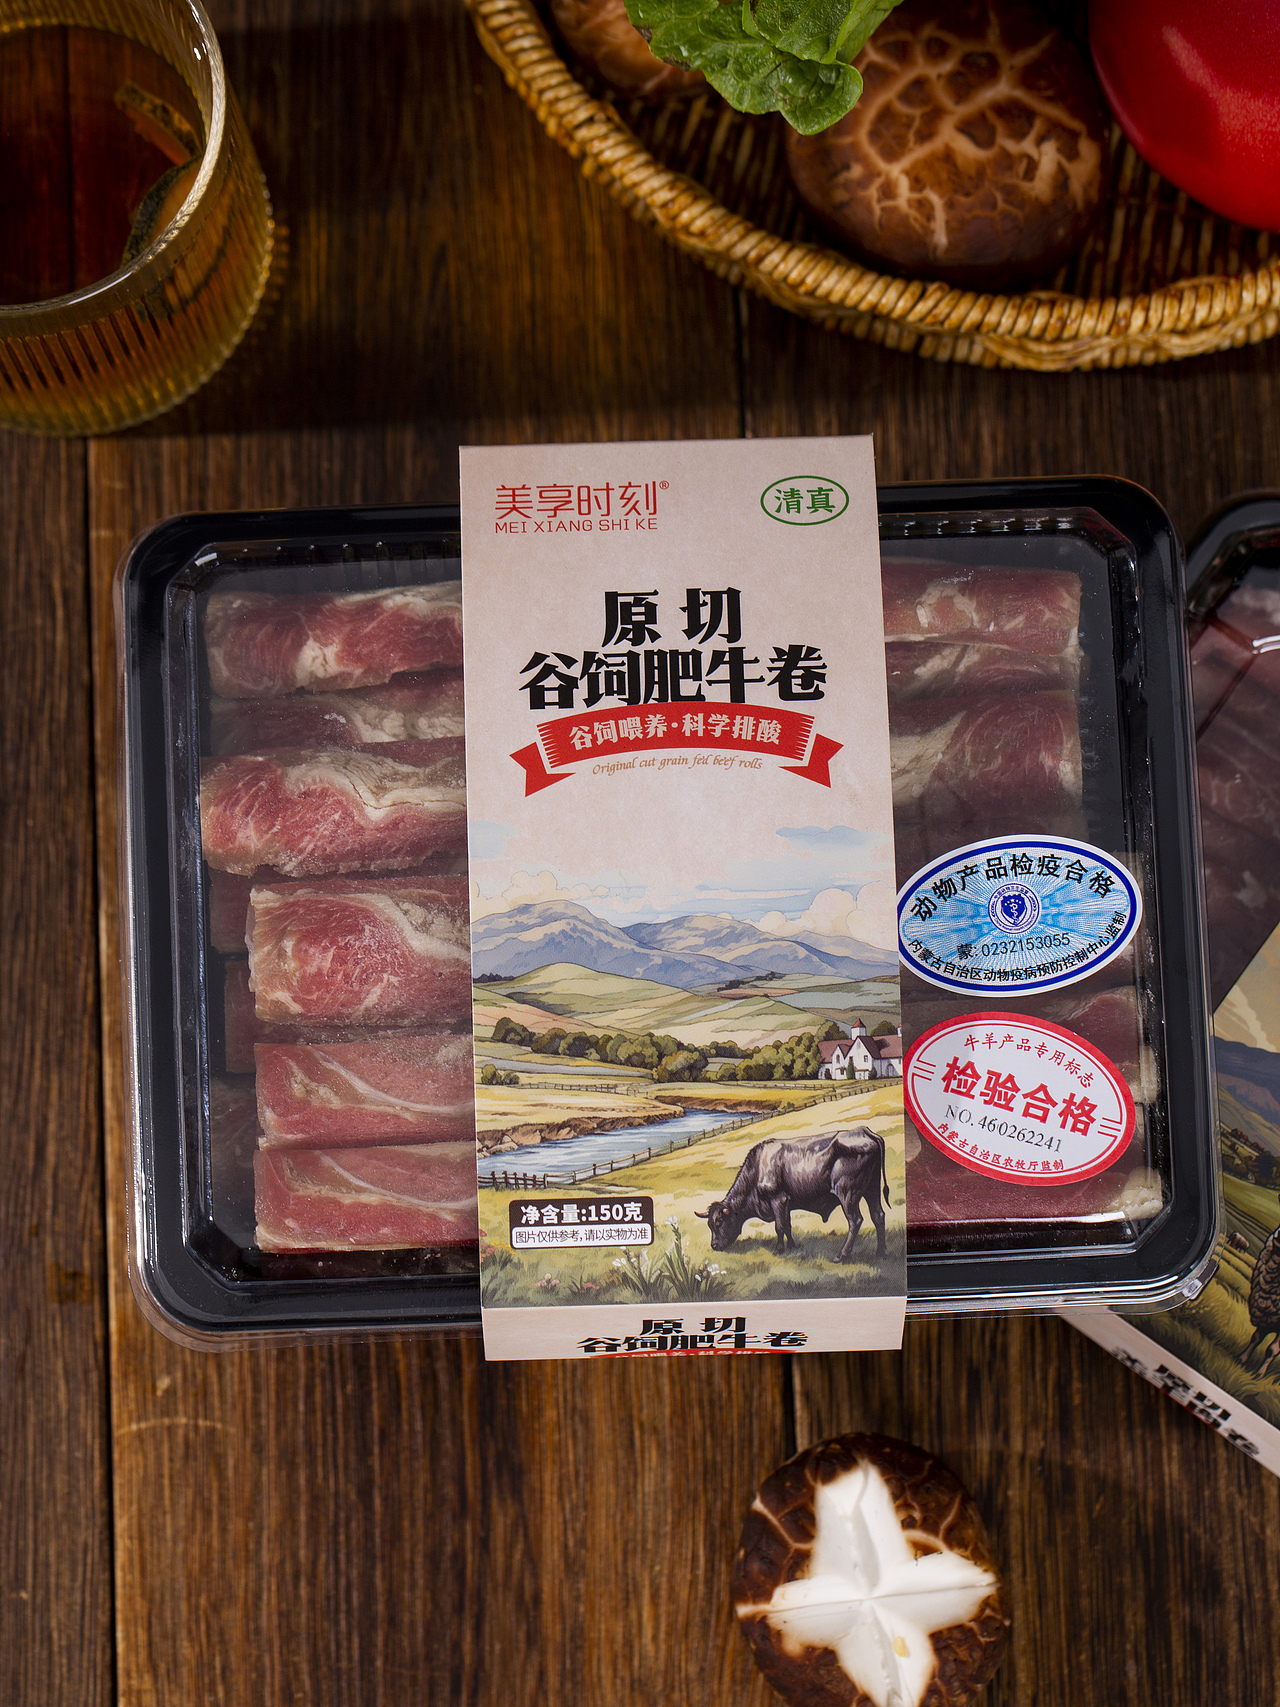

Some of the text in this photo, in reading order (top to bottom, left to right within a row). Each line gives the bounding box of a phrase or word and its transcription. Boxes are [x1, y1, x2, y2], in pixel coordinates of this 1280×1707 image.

[774, 487, 835, 514] 清真
[495, 517, 658, 533] MEI XIANG SHI KE
[602, 587, 742, 648] 原切
[519, 644, 828, 709] 谷饲肥牛卷
[592, 754, 763, 776] Original cut grain fed beef rolls
[910, 853, 1116, 922] 动物产品检疫合格
[963, 1033, 1094, 1088] 牛羊产品专用标志
[941, 1056, 1099, 1137] 检验合格
[937, 1123, 1064, 1171] 内蒙古自治区农牧厅监制
[520, 1202, 643, 1225] 净含量:150克
[576, 1331, 808, 1353] 谷饲肥牛卷
